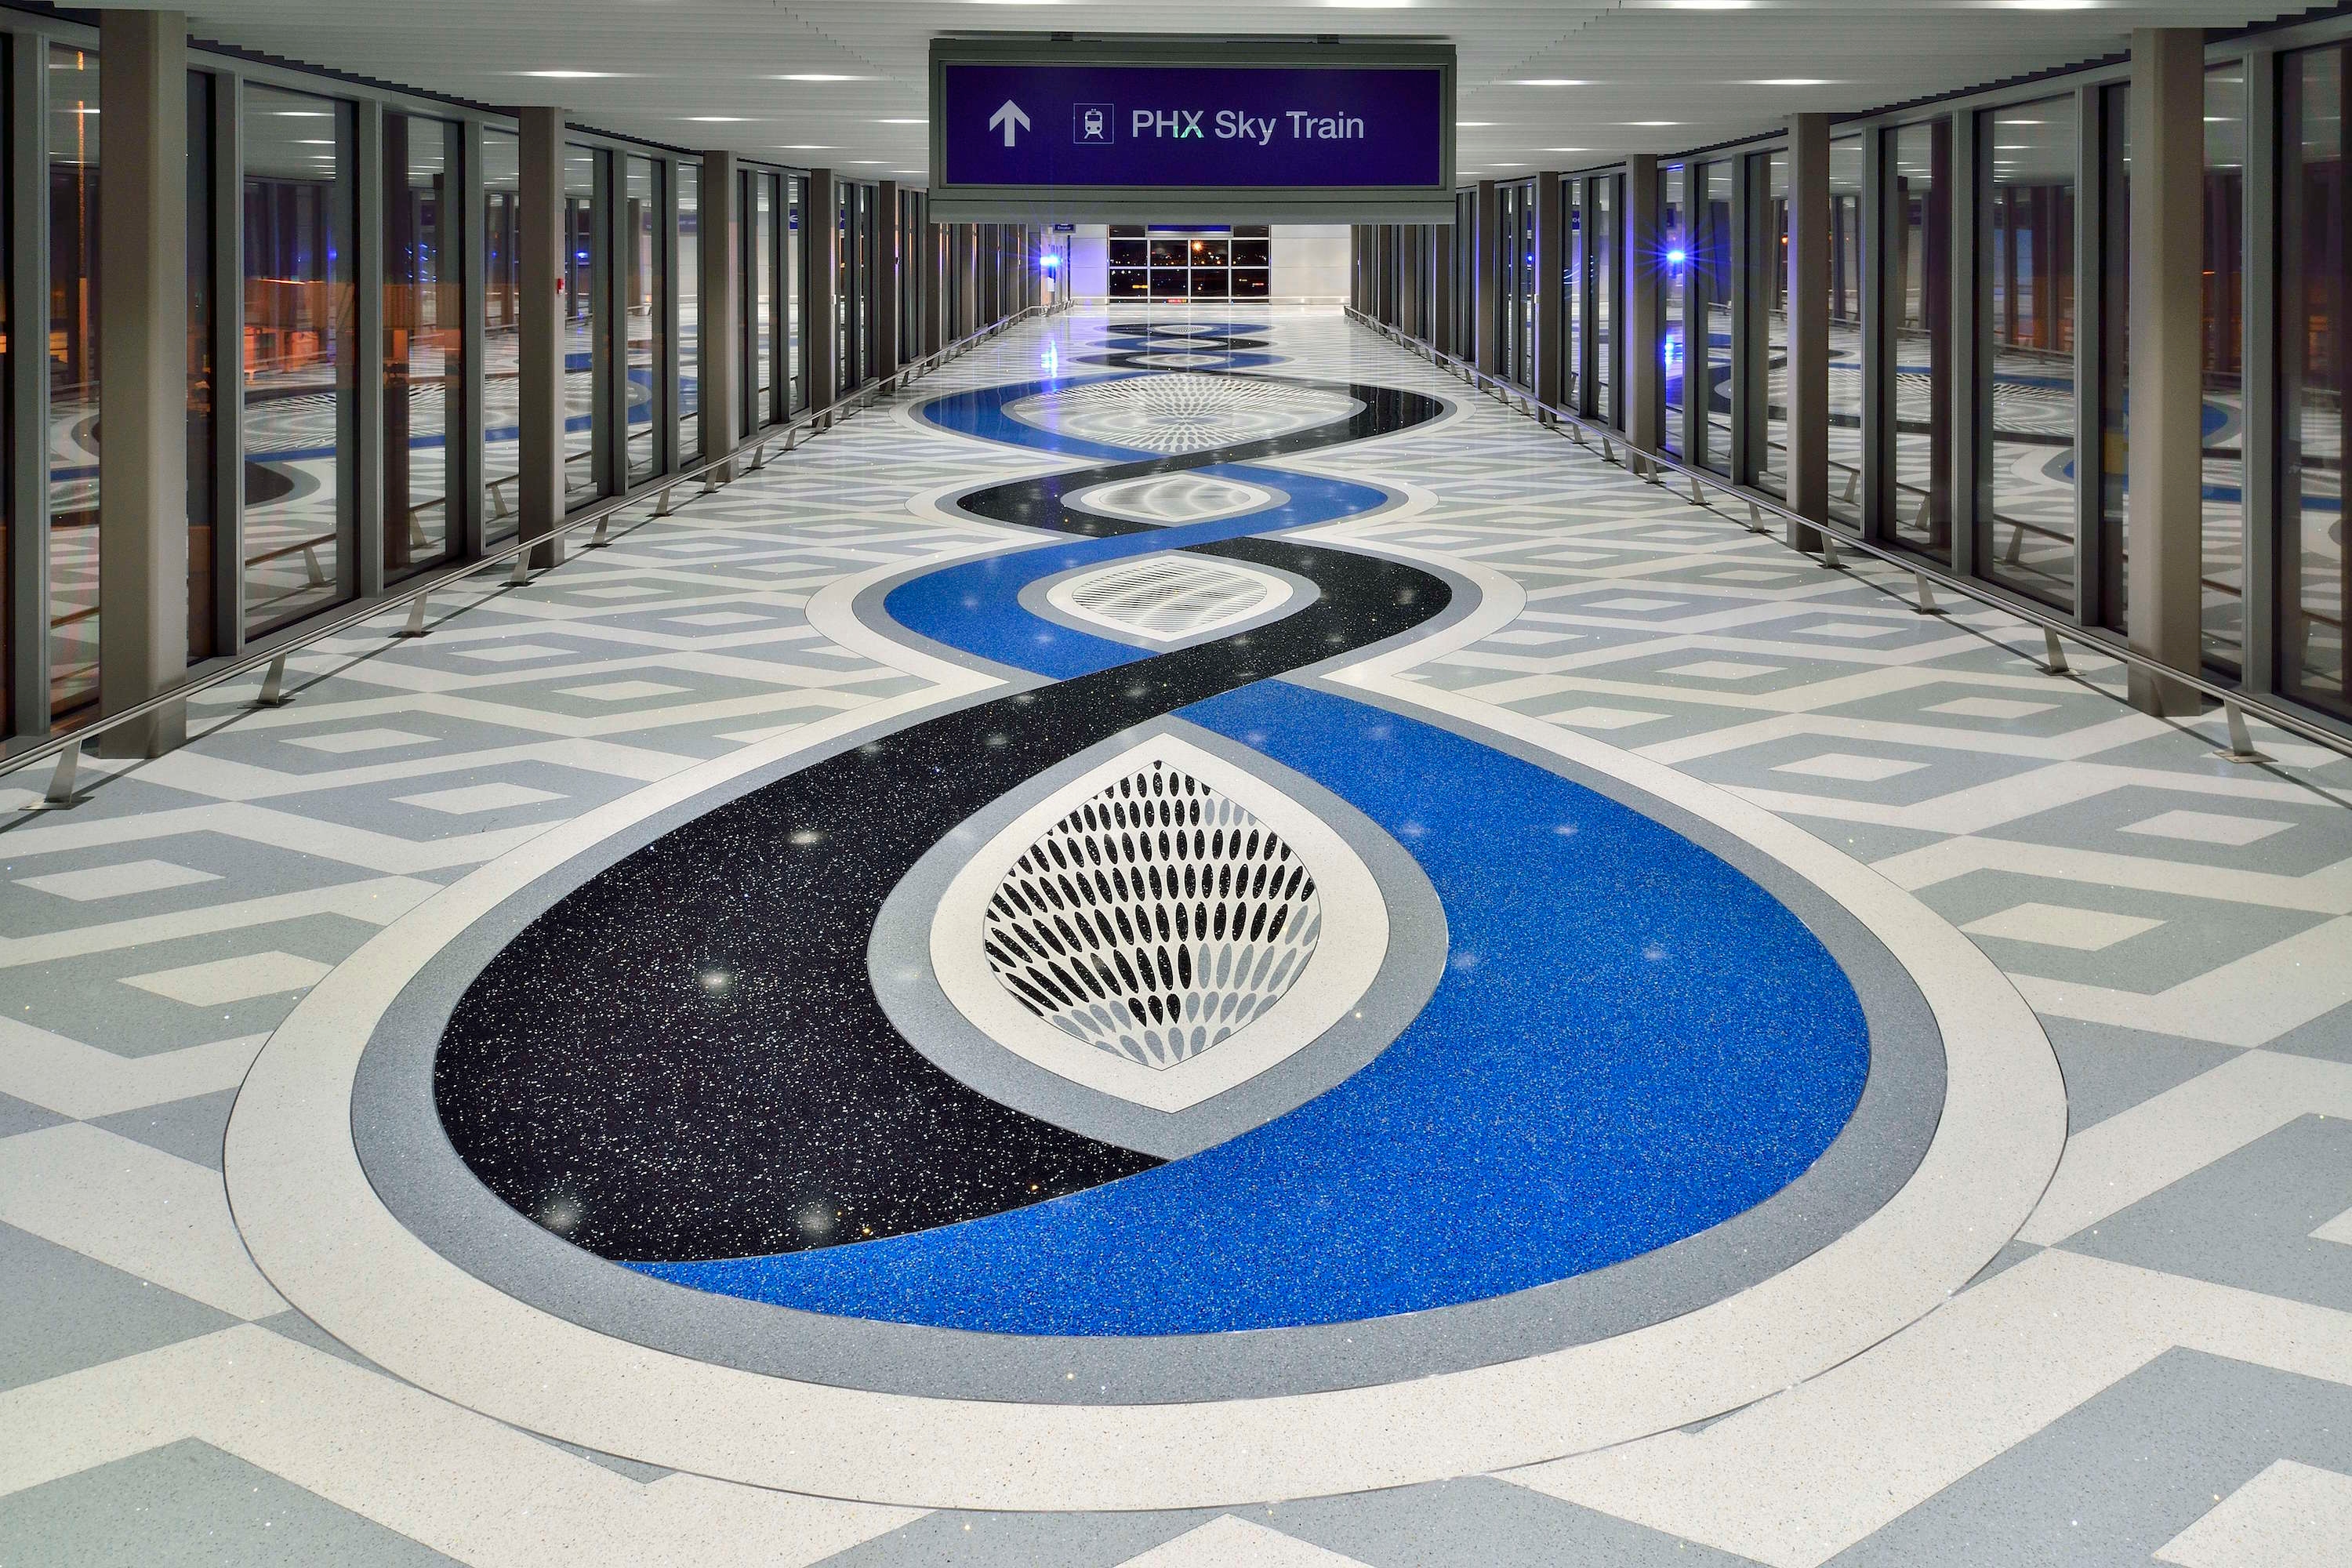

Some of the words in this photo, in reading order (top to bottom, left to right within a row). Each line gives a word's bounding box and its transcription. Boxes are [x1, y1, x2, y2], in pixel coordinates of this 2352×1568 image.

[1132, 111, 1205, 139] PHX
[1214, 111, 1277, 146] Sky
[1285, 111, 1364, 139] Train
